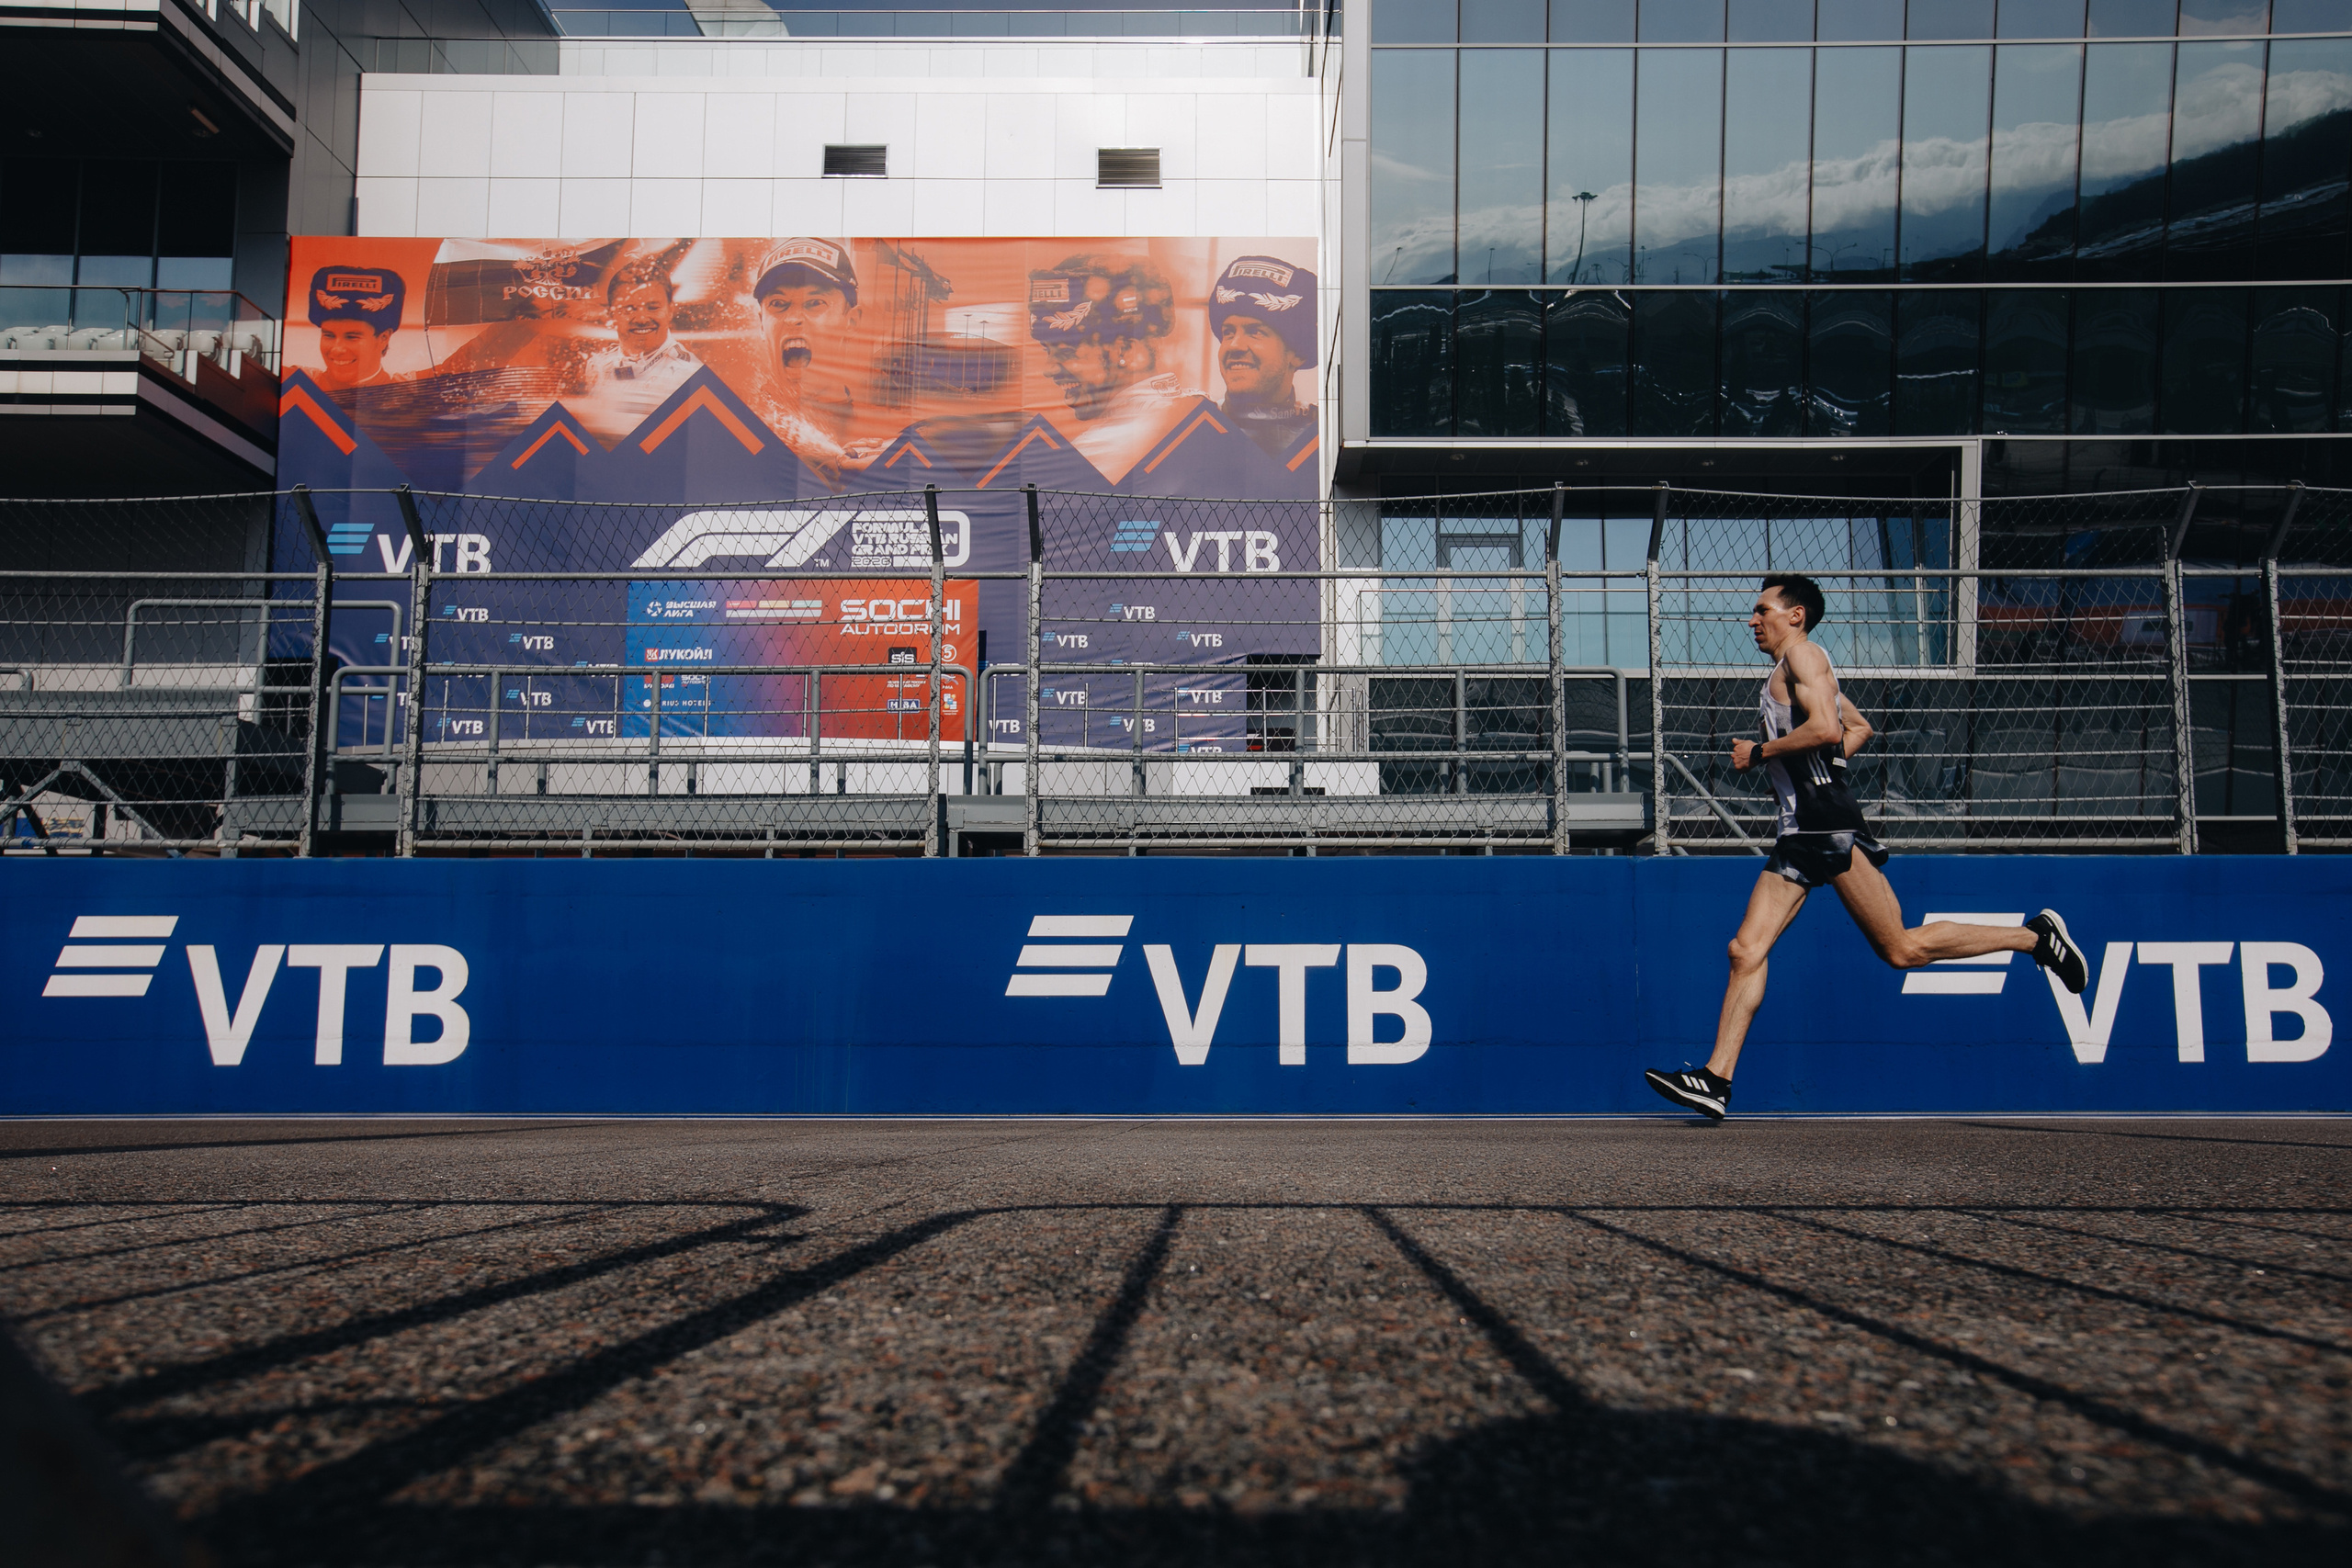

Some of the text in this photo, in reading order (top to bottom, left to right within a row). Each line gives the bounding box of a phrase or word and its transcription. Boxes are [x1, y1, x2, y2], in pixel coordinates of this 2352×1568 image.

[1232, 264, 1286, 282] PIRELLI
[331, 276, 377, 289] PIRELLI
[377, 533, 492, 574] VTB
[851, 544, 909, 556] GRAND
[1163, 530, 1281, 572] VTB
[457, 607, 489, 622] VTB
[662, 609, 694, 618] ЛИГА
[1123, 605, 1156, 620] VTB
[840, 623, 961, 636] AUTODRM
[522, 635, 554, 650] VTB
[1056, 634, 1089, 649] VTB
[1190, 633, 1223, 648] VTB
[658, 646, 713, 660] ЛУКОЙЛ
[519, 691, 552, 706] VTB
[1056, 691, 1086, 705] VTB
[1190, 691, 1223, 704] VTB
[451, 719, 484, 735] VTB
[585, 719, 614, 735] VTB
[989, 719, 1021, 733] VTB
[1123, 718, 1156, 733] VB
[186, 943, 470, 1066] VTB
[1142, 943, 1433, 1066] VTB
[2043, 941, 2334, 1064] VTB
